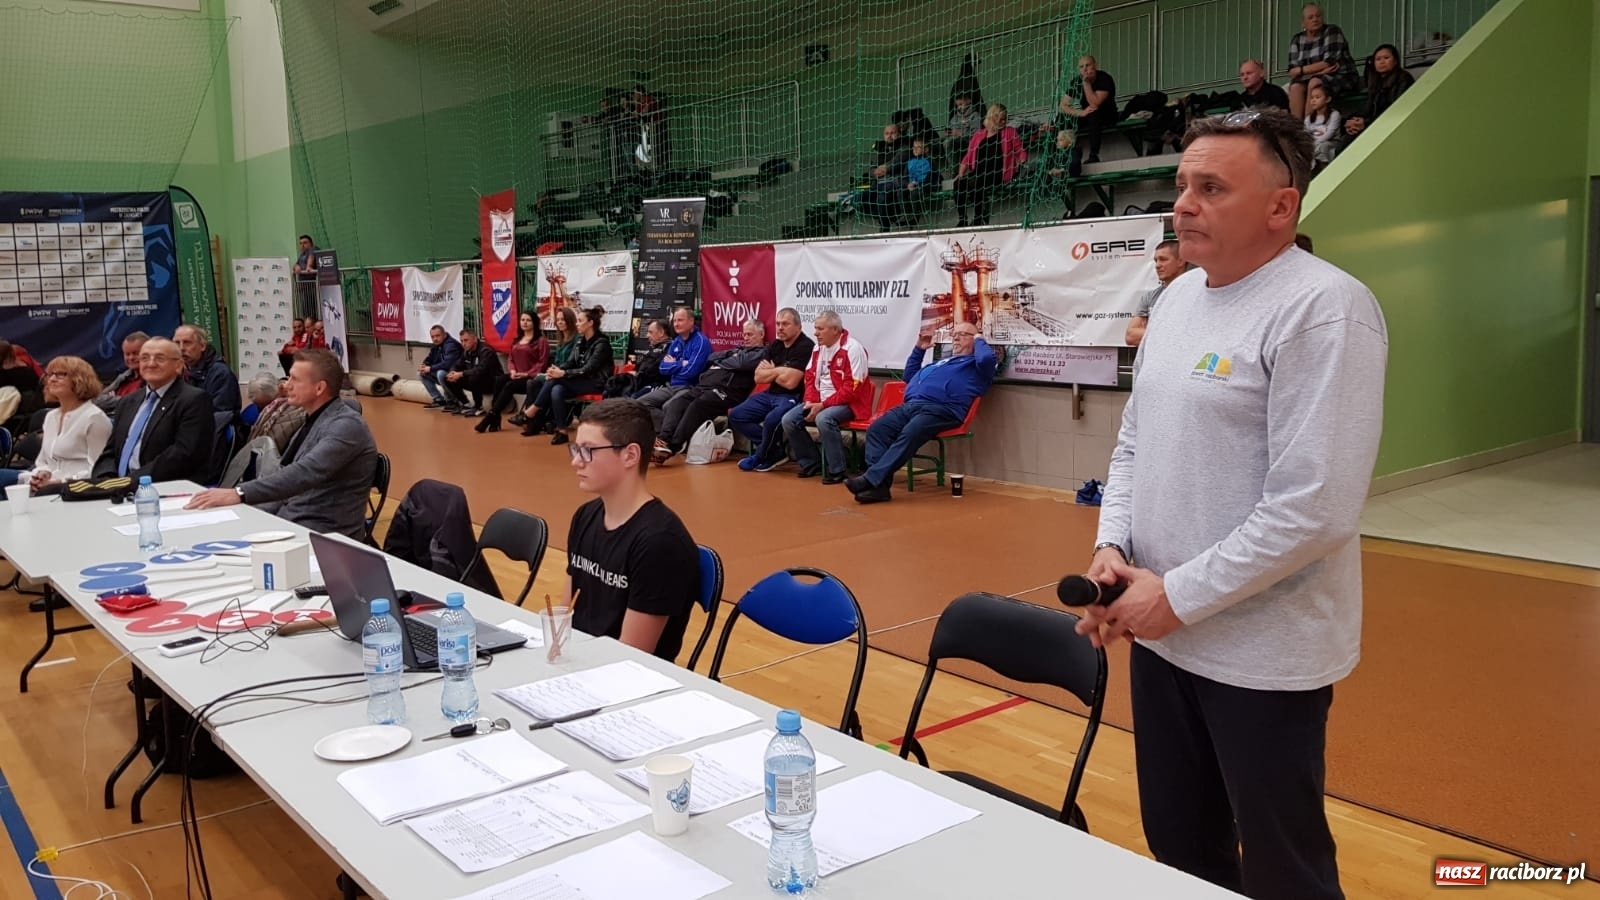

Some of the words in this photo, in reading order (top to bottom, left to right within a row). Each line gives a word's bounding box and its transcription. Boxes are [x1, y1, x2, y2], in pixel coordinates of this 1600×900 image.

[1091, 239, 1145, 253] GAZ
[796, 281, 833, 298] SPONSOR
[835, 281, 889, 298] TYTULARNY
[891, 280, 910, 298] PZZ
[377, 303, 400, 319] PWPW
[714, 301, 760, 327] PWPW
[1076, 311, 1133, 320] www.gaz-system.
